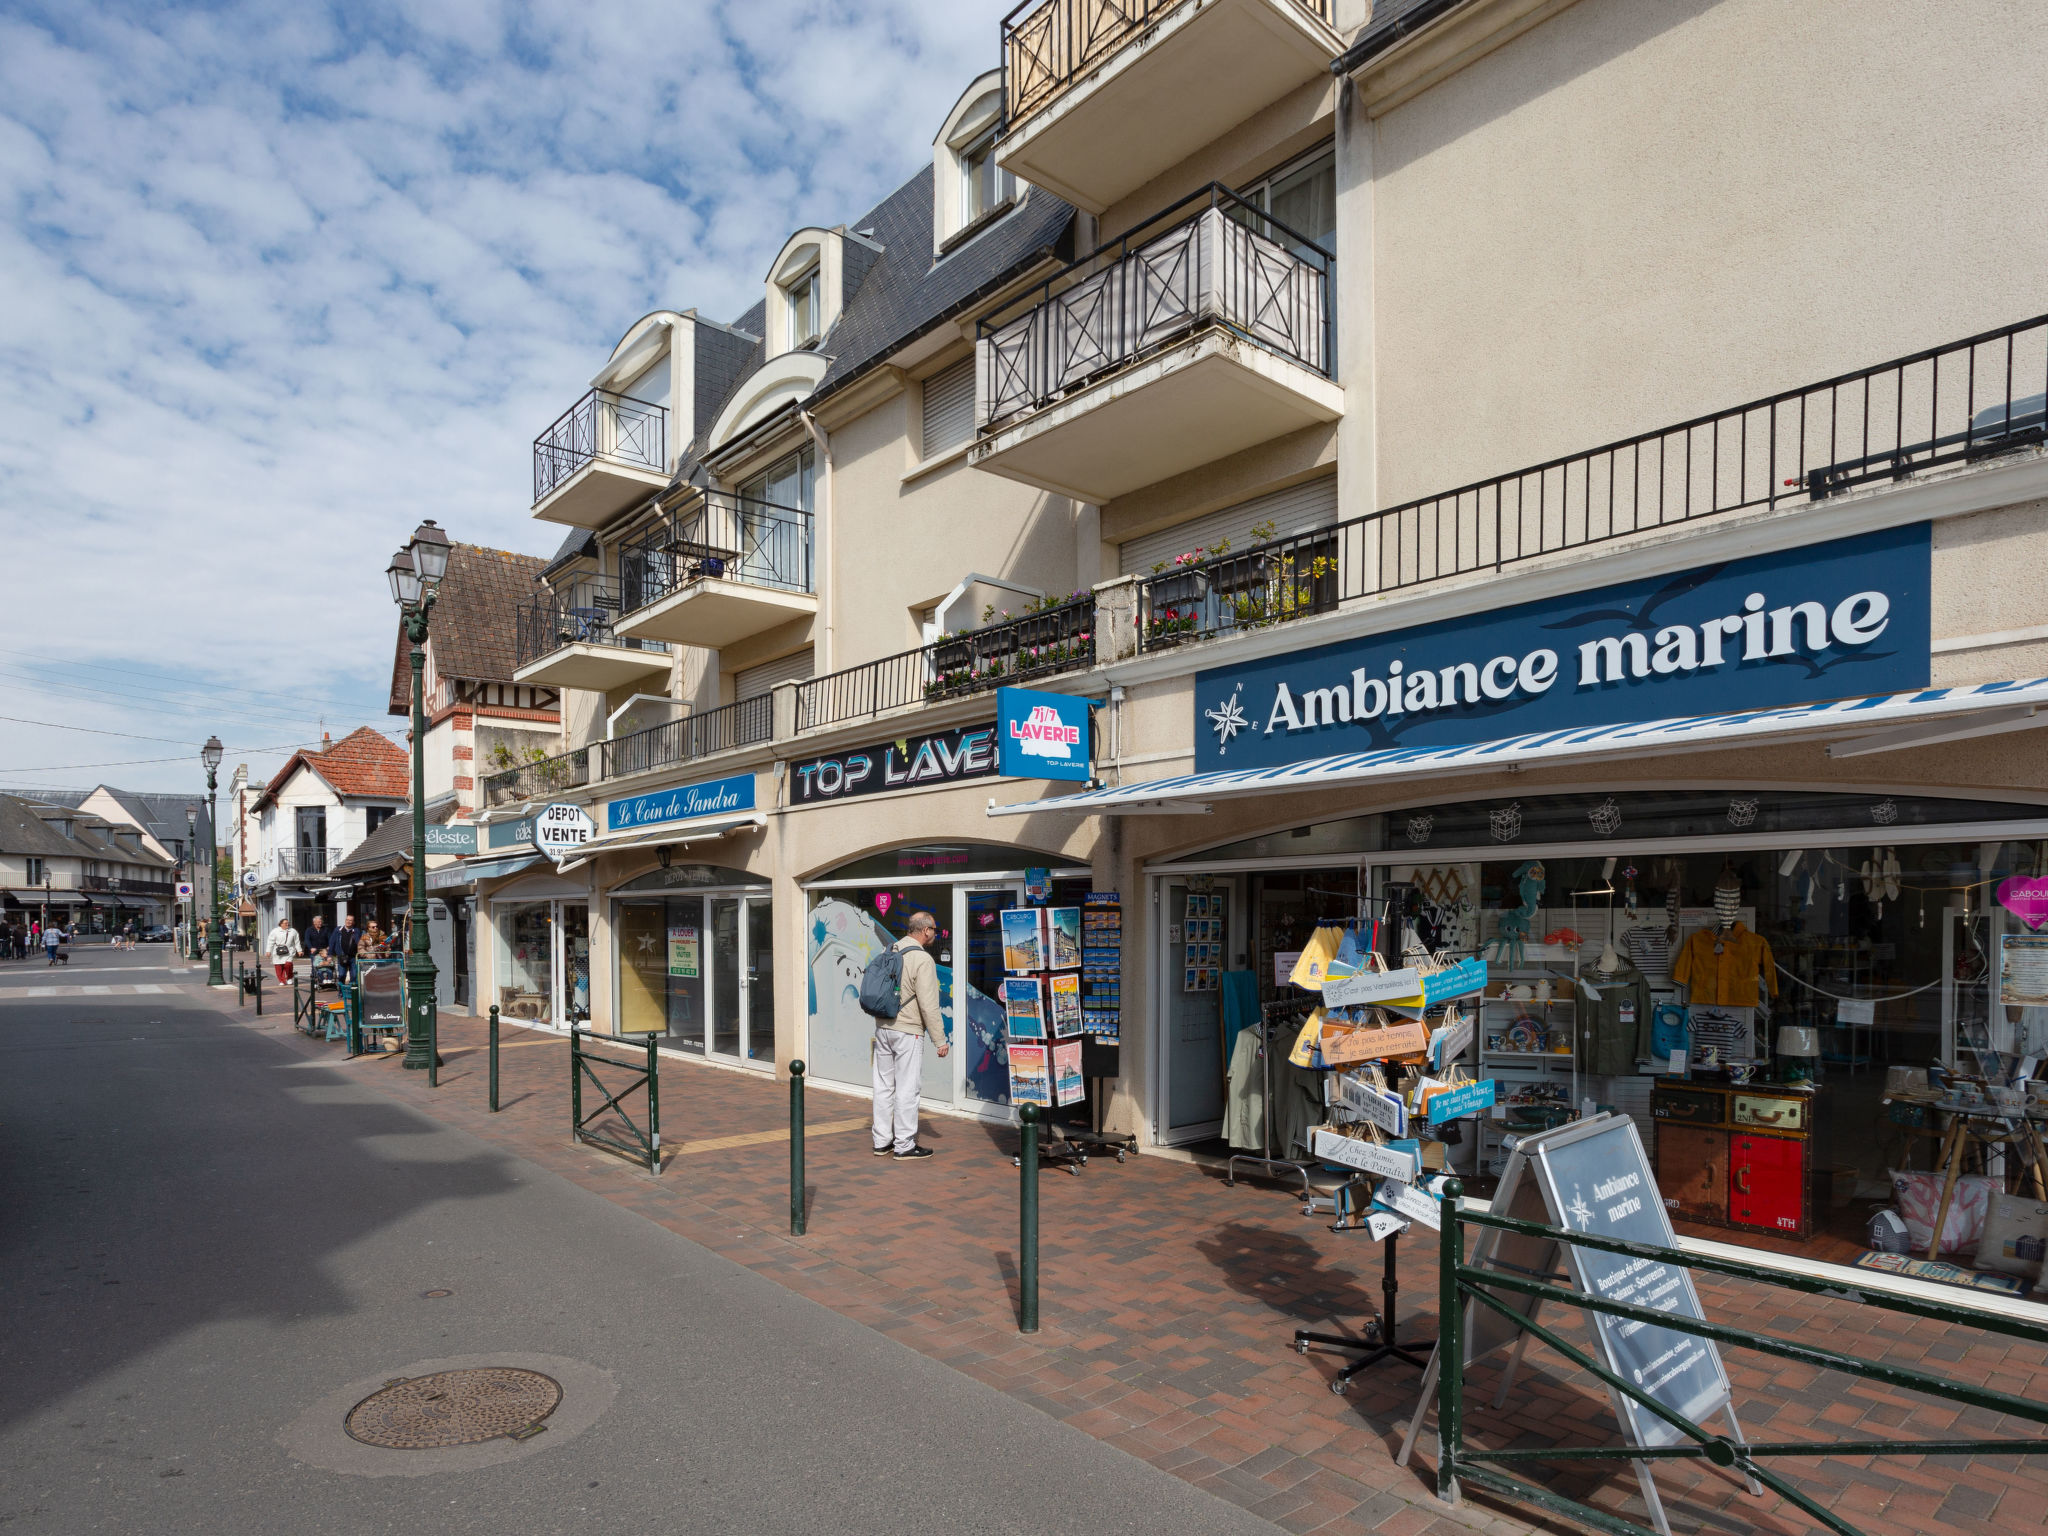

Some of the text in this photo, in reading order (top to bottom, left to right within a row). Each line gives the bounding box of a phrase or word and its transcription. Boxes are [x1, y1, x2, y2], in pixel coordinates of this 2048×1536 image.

[1264, 590, 1891, 734] Ambiance marine
[1033, 706, 1056, 723] 7j/7
[1010, 720, 1079, 744] LAVERIE
[797, 753, 870, 799] TOP
[617, 785, 742, 826] Le Coin de Sandra
[548, 807, 581, 822] DEPOT
[542, 827, 587, 843] VENTE
[1087, 893, 1118, 901] MAGNETS
[2010, 890, 2048, 898] CABOU
[1359, 1046, 1373, 1055] suis
[1386, 1040, 1417, 1052] retraite
[1361, 1036, 1376, 1046] pas
[1377, 1033, 1385, 1042] le
[1012, 1049, 1040, 1057] CABOURG
[1461, 1092, 1471, 1103] pas
[1349, 1145, 1368, 1157] Chez
[1360, 1156, 1368, 1167] le
[1370, 1160, 1406, 1178] Paradis
[1593, 1171, 1640, 1203] Ambiance
[1607, 1196, 1642, 1223] marine
[1776, 1216, 1796, 1229] 4TH
[1597, 1269, 1627, 1291] Boutique
[1625, 1263, 1634, 1276] de
[1635, 1265, 1667, 1289] Souvenirs
[1647, 1276, 1681, 1302] Luminaires
